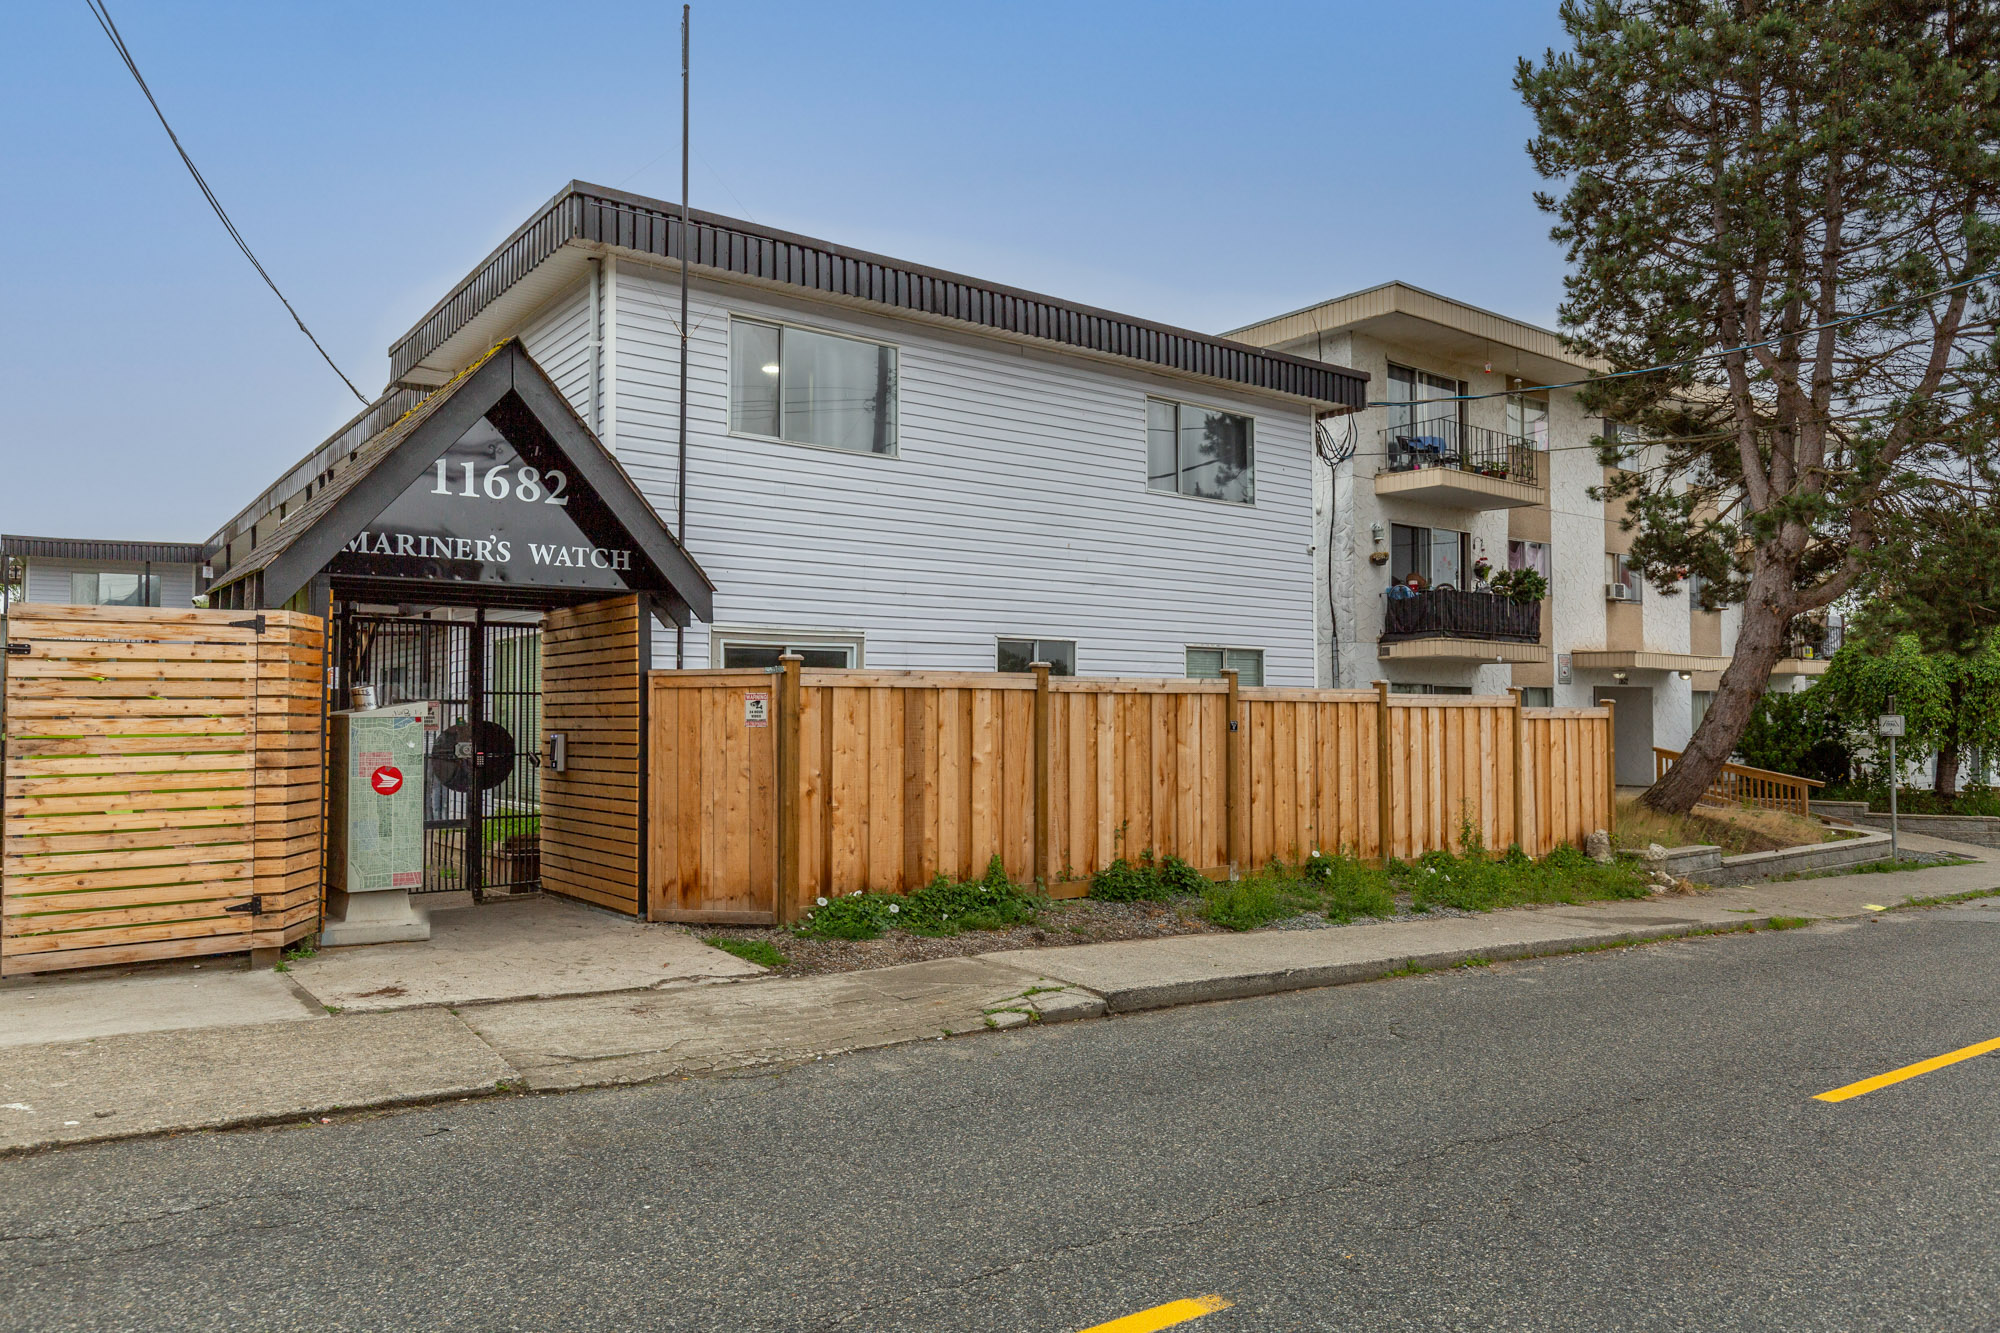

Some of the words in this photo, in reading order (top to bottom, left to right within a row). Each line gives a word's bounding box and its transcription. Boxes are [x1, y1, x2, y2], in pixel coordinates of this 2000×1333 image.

[431, 458, 569, 506] 11682
[342, 531, 511, 563] MARINER'S
[527, 544, 631, 571] WATCH
